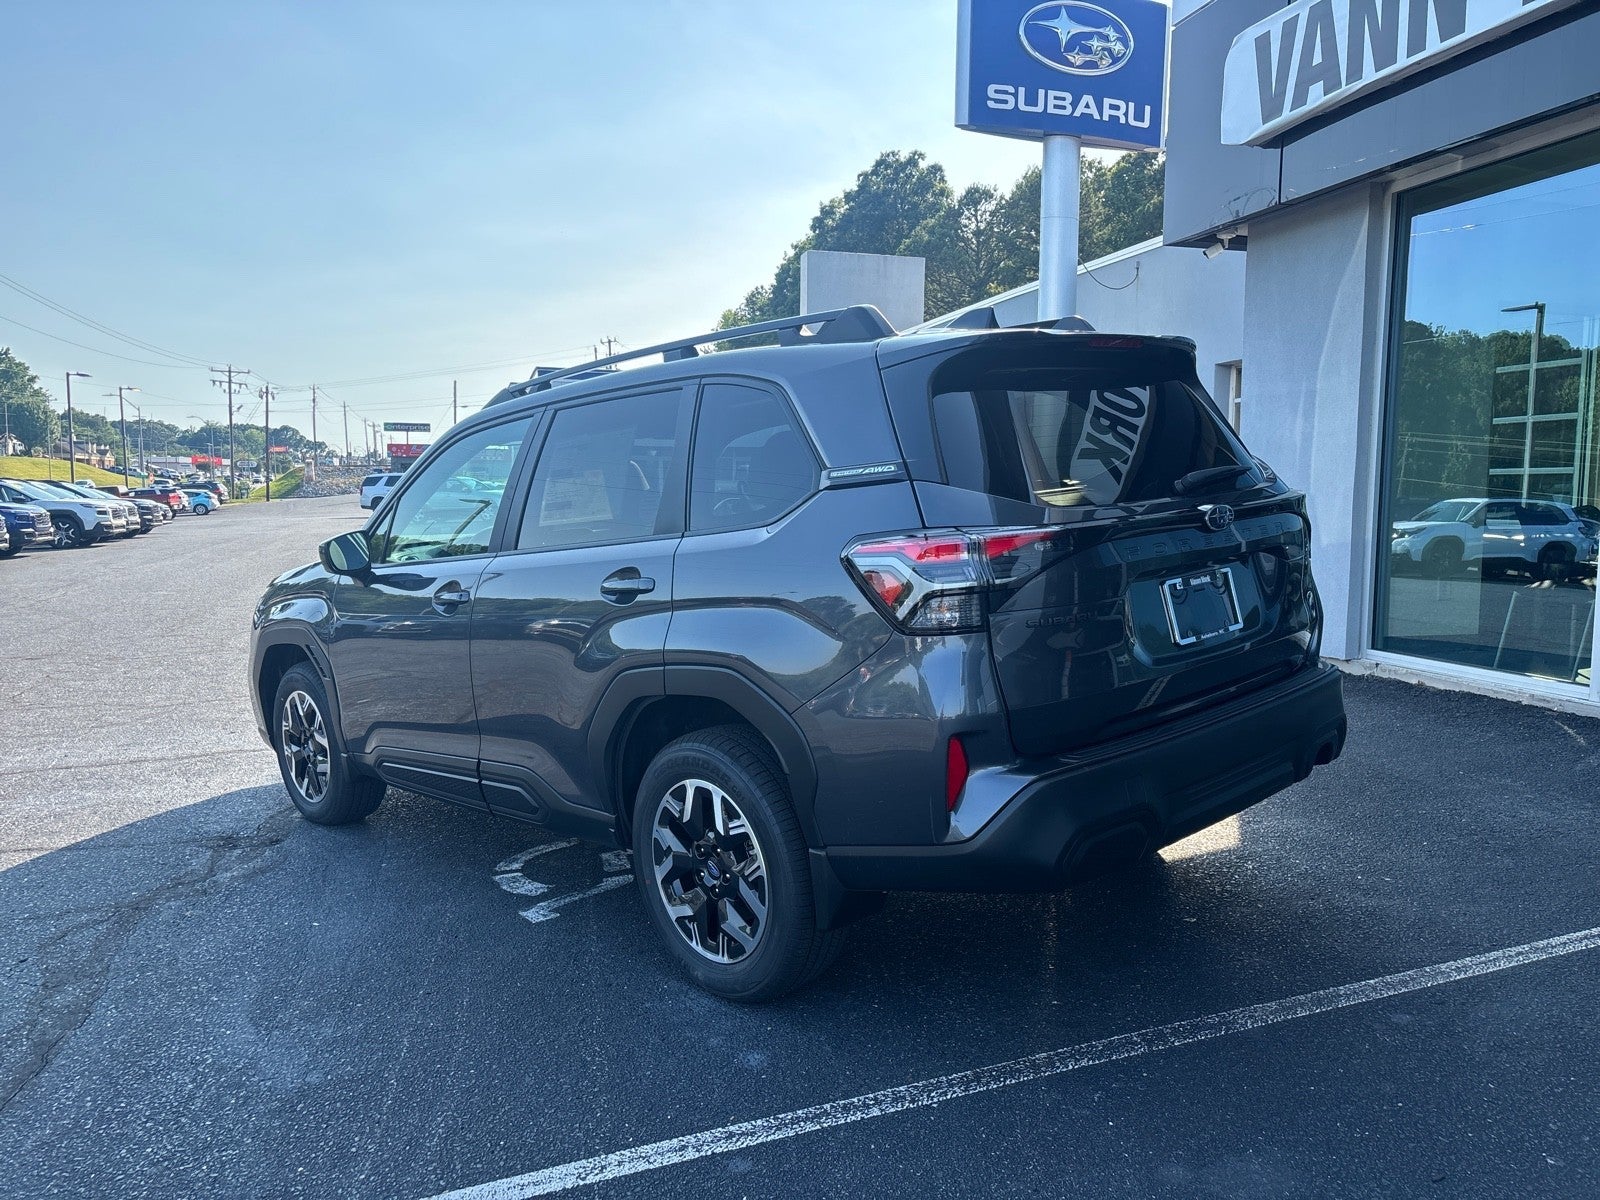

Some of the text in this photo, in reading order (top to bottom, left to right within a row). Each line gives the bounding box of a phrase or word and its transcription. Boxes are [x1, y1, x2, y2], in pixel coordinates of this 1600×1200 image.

[1254, 0, 1467, 126] VANN
[986, 83, 1151, 129] SUBARU
[863, 465, 895, 474] AWD
[1124, 521, 1285, 560] FORESTER
[1025, 611, 1098, 629] SUBARU
